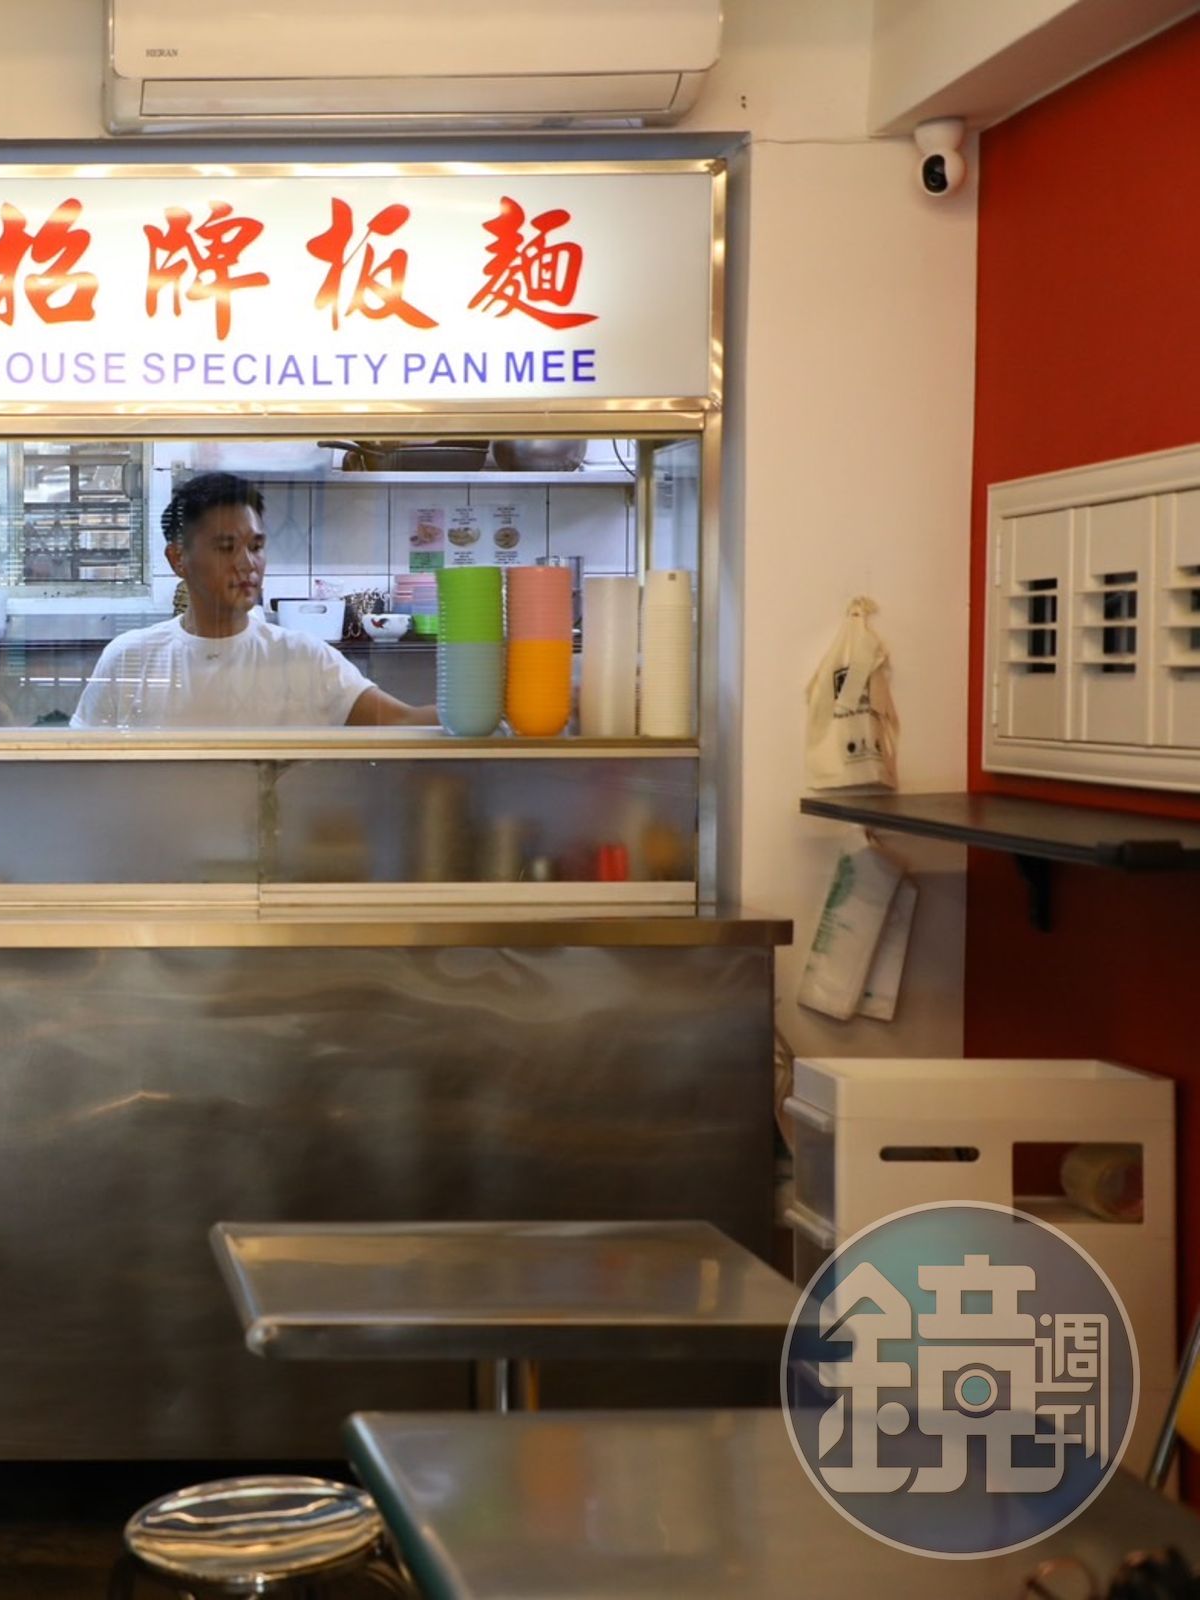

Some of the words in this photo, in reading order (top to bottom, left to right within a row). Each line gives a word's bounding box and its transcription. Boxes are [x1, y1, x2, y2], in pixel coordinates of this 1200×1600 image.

[142, 352, 388, 386] SPECIALTY
[404, 351, 488, 385] PAN
[505, 348, 597, 383] MEE
